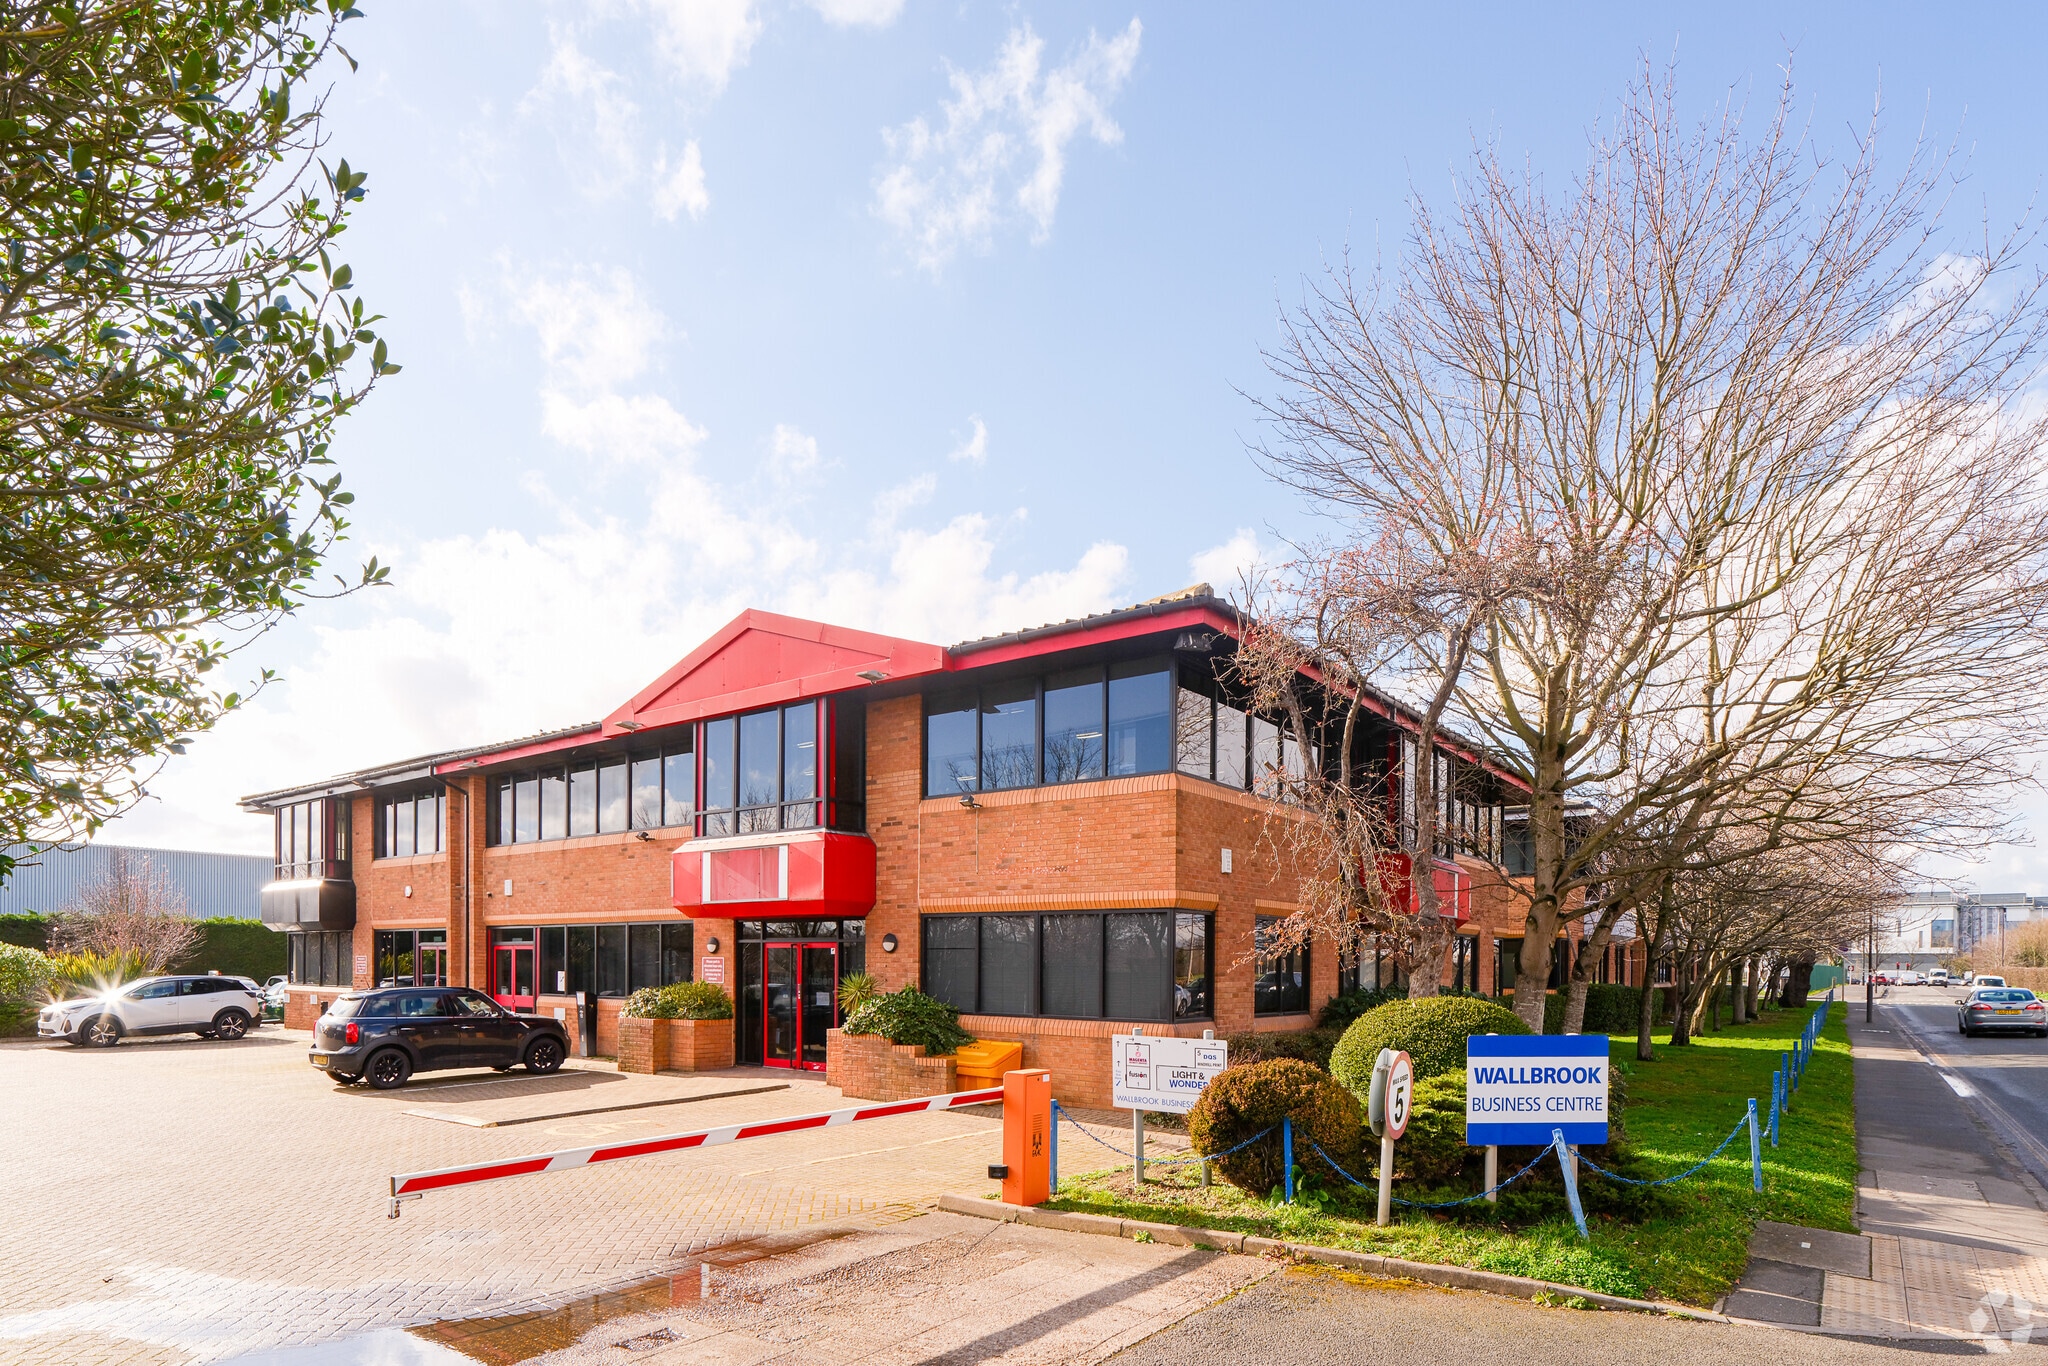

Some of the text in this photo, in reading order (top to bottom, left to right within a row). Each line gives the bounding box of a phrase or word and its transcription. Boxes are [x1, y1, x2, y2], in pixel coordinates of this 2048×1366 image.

[1172, 1070, 1205, 1080] LIGHT &
[1399, 1073, 1409, 1083] SPEED
[1473, 1066, 1602, 1085] WALLBROOK
[1116, 1095, 1194, 1108] WALLBROOK BUSINESS
[1394, 1085, 1404, 1124] 5
[1472, 1096, 1603, 1112] BUSINESS CENTRE
